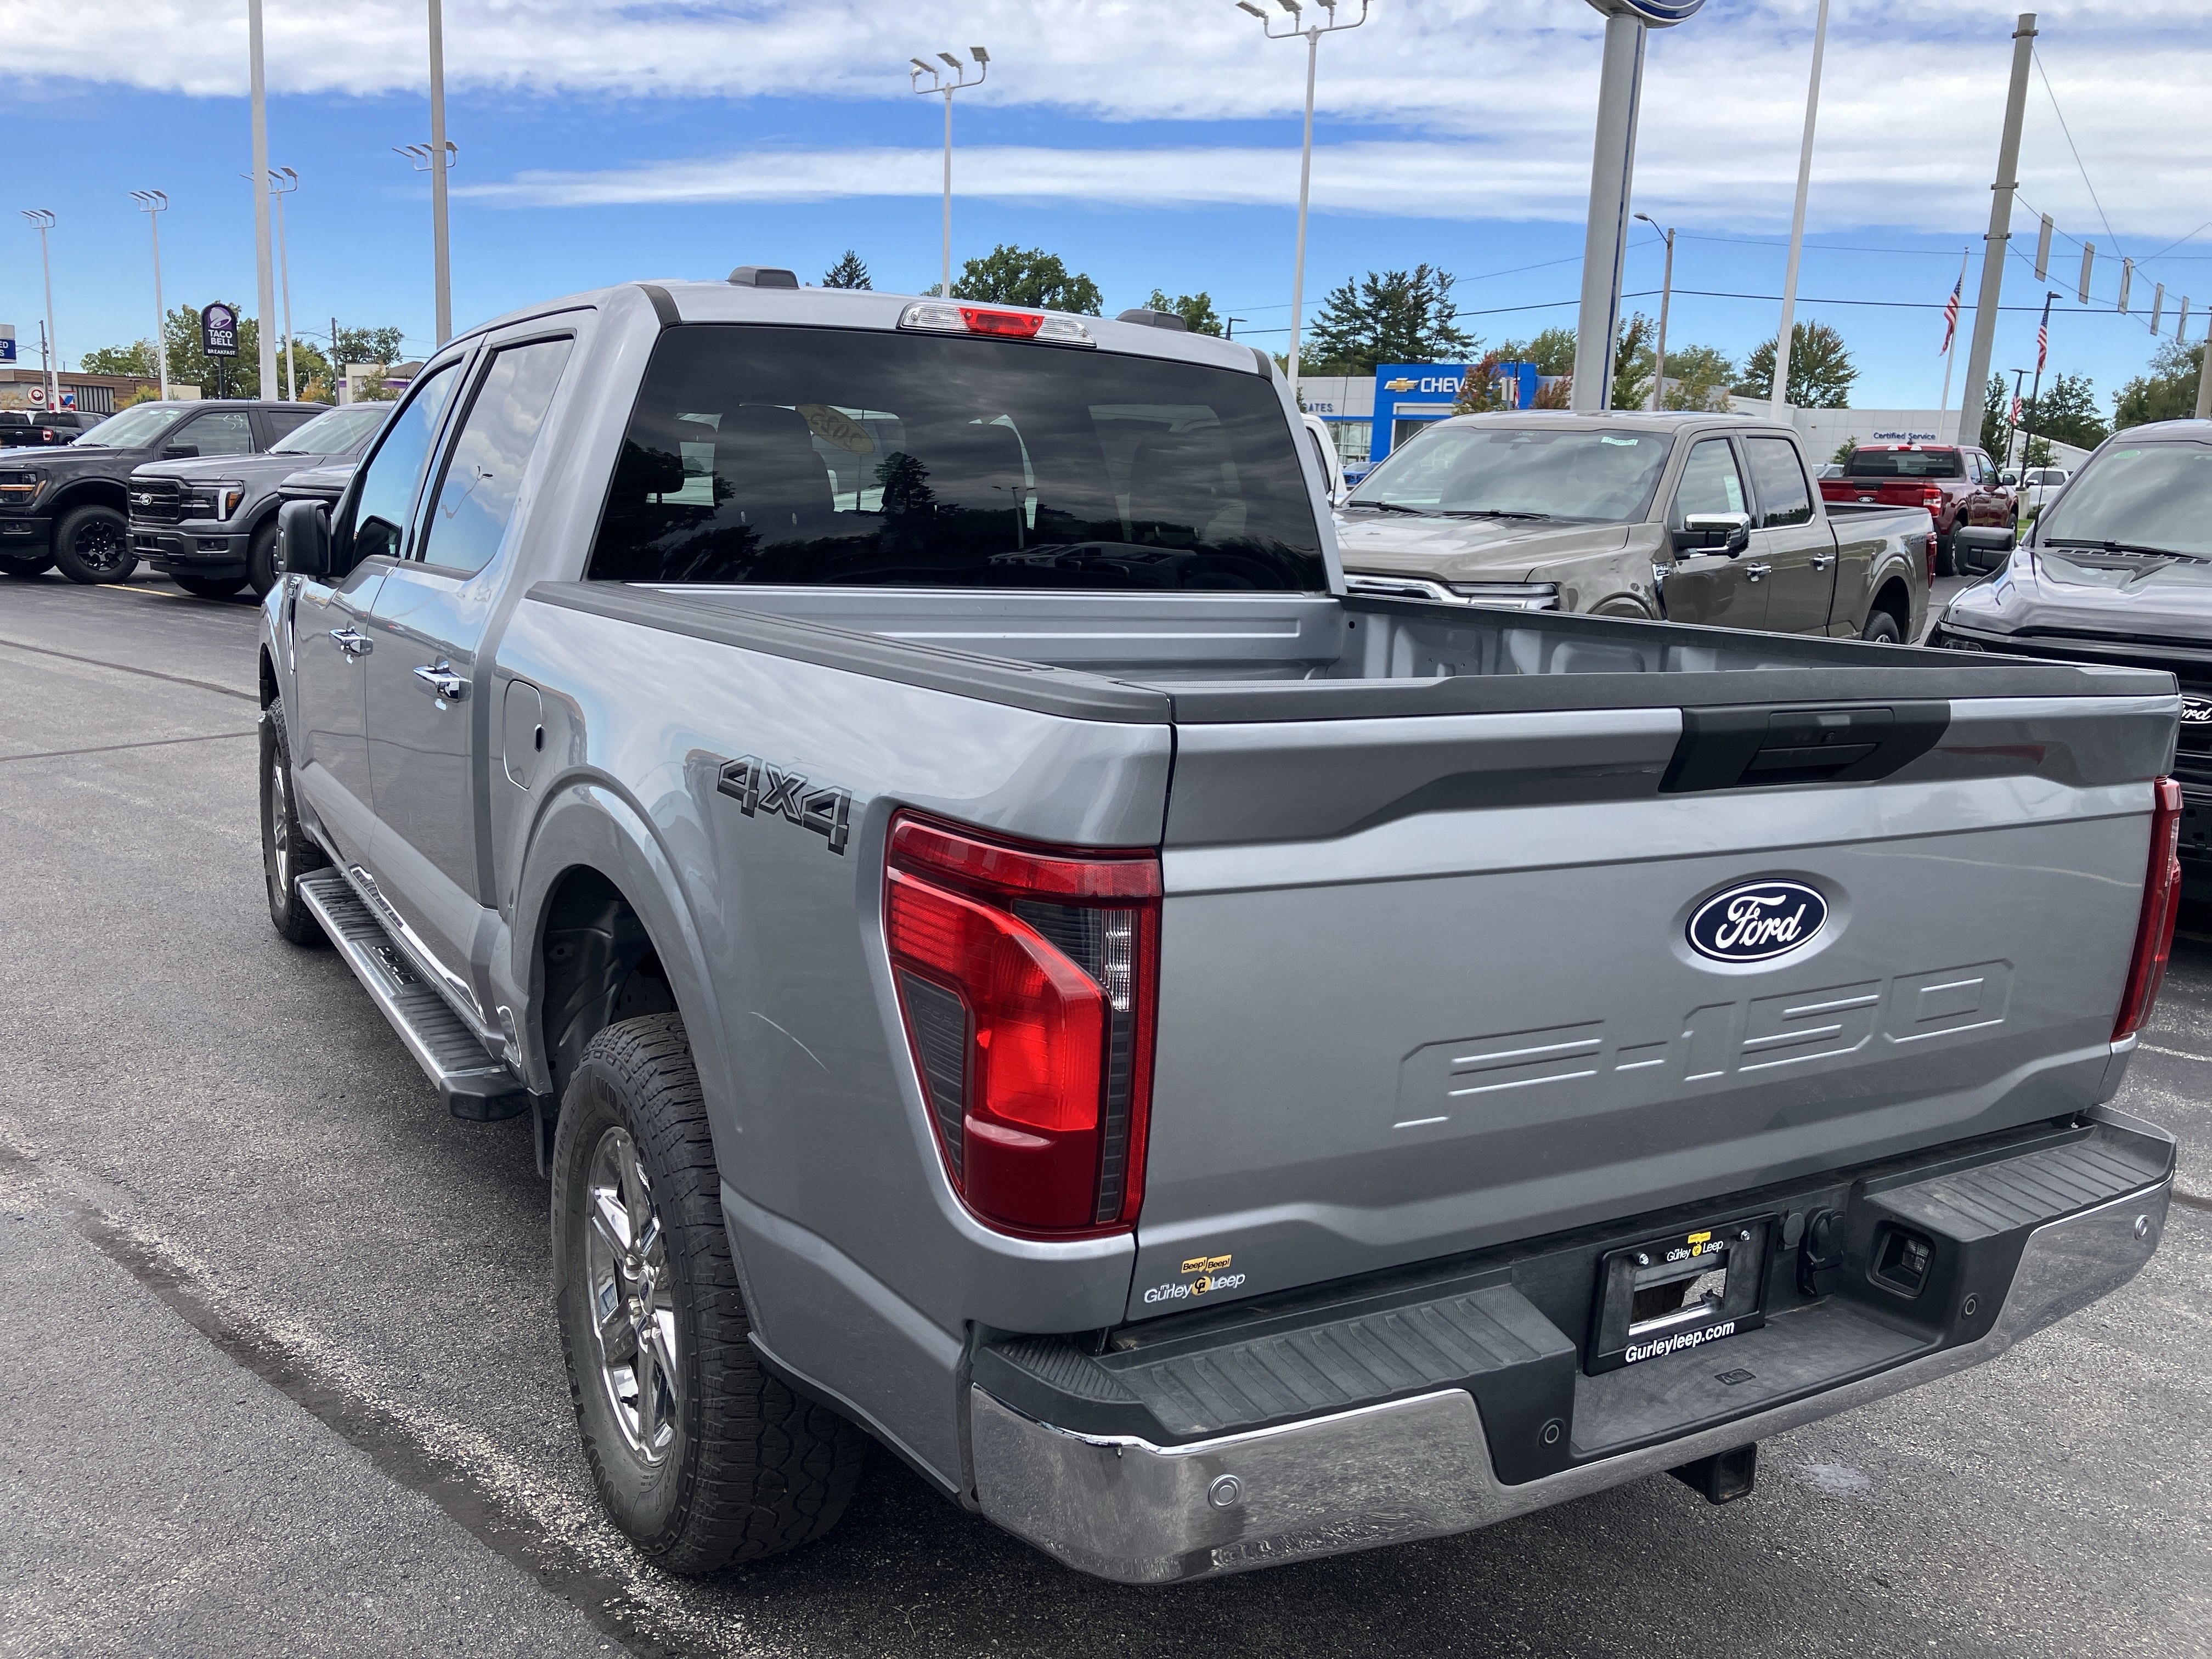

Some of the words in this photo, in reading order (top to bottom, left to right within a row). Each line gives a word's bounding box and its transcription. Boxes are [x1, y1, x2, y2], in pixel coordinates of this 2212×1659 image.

[208, 329, 233, 338] TACO
[211, 337, 233, 346] BELL
[2182, 700, 2212, 720] rd
[1715, 894, 1807, 949] Ford
[1392, 958, 2015, 1129] F-150
[1667, 1248, 1691, 1261] Gurley
[1702, 1240, 1724, 1254] Leep
[1183, 1260, 1206, 1271] Beep!
[1207, 1258, 1230, 1269] Beep!
[1144, 1283, 1193, 1304] Gurley
[1210, 1273, 1246, 1291] Leep
[1625, 1321, 1735, 1363] Gurleyleep.com
